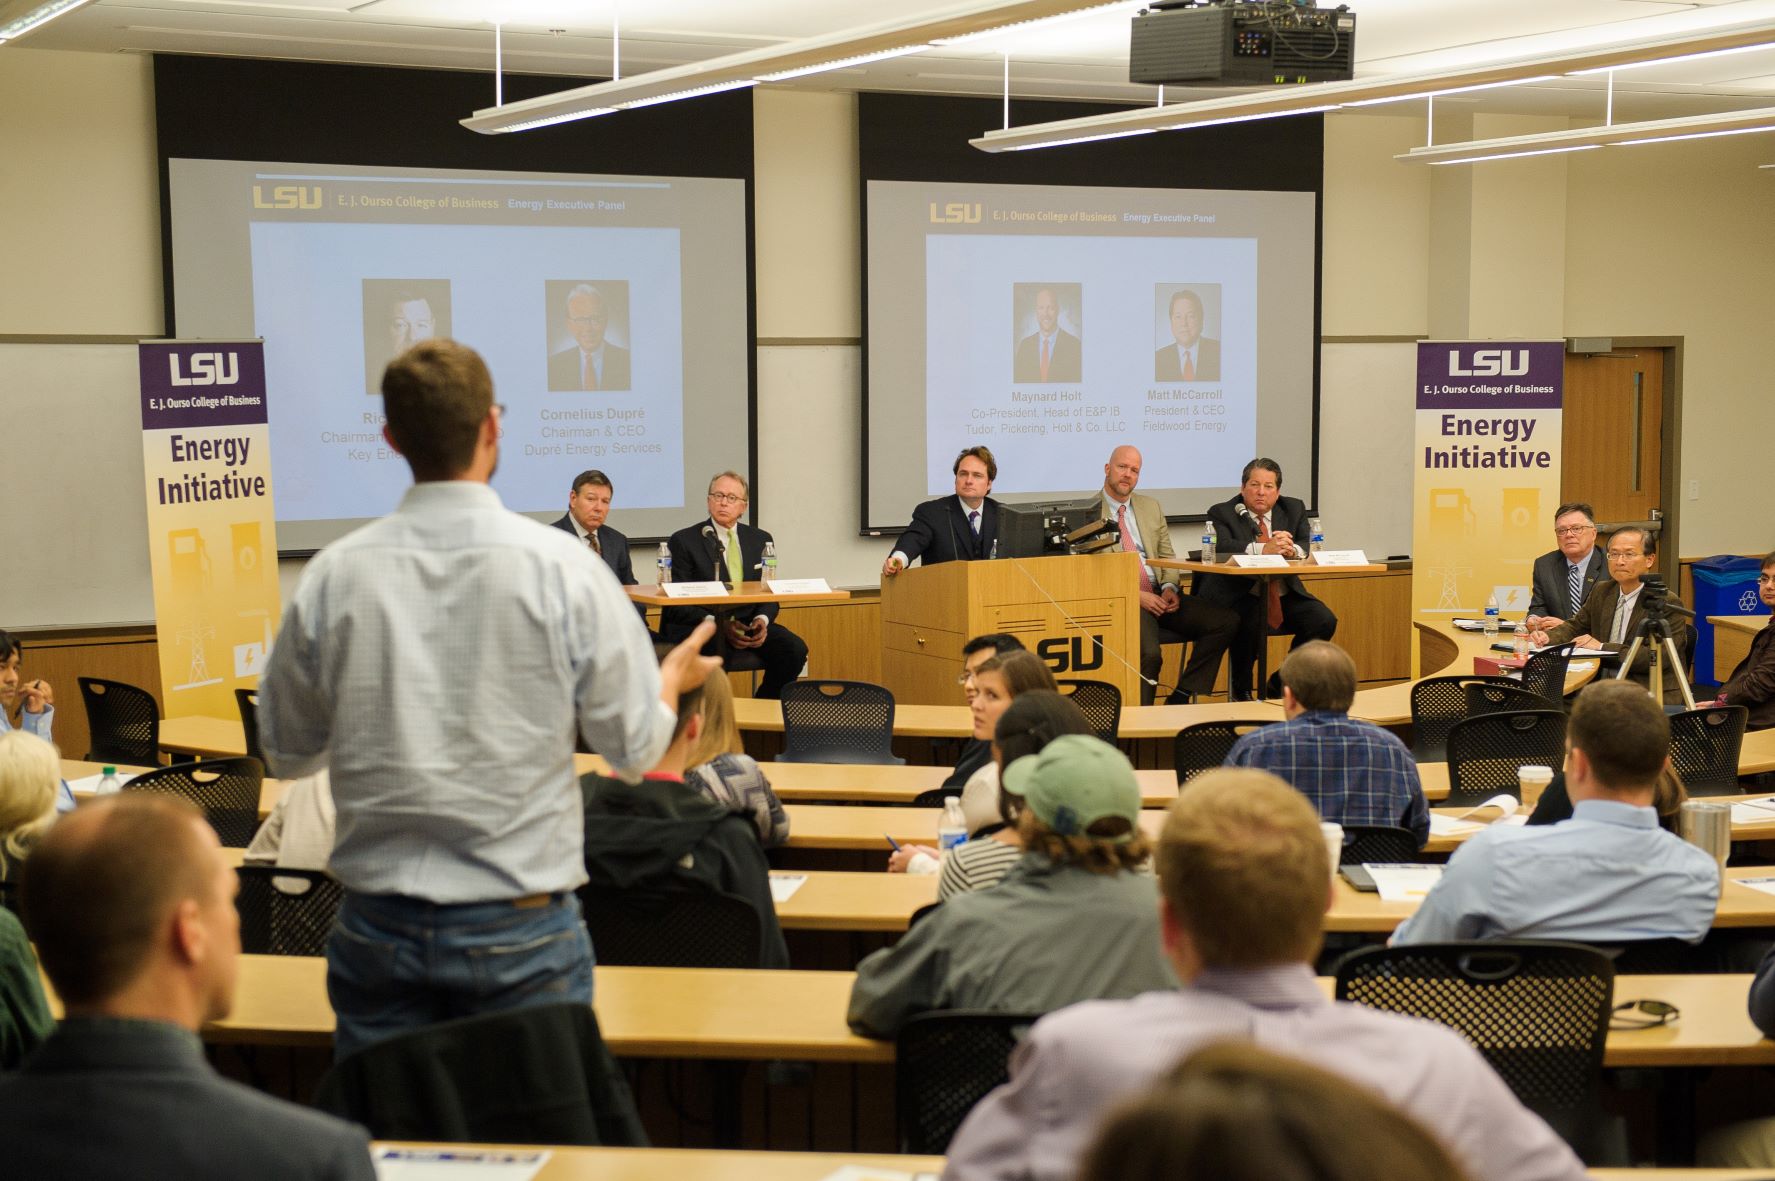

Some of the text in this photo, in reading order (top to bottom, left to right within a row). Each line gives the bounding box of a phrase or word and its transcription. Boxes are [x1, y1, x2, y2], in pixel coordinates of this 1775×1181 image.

[252, 186, 322, 209] LSU
[338, 195, 348, 206] E.
[361, 196, 393, 207] Ourso
[395, 196, 435, 210] College
[438, 196, 450, 208] of
[452, 197, 499, 209] Business
[508, 199, 544, 211] Energy
[547, 200, 594, 210] Executive
[598, 201, 625, 210] Panel
[930, 203, 981, 223] LSU
[1010, 211, 1035, 221] Ourso
[1037, 211, 1068, 223] College
[1070, 212, 1079, 222] of
[1080, 212, 1117, 222] Business
[1124, 213, 1151, 224] Energy
[1154, 214, 1191, 223] Executive
[1194, 214, 1216, 223] Panel
[169, 352, 239, 386] LSU
[1449, 350, 1529, 376] LSU
[1147, 389, 1222, 400] Matt McCarroll
[1424, 385, 1554, 395] E. J. Ourso College of Business
[150, 395, 261, 410] E. J. Ourso College of Business
[1012, 391, 1082, 403] Maynard Holt
[540, 408, 645, 421] Cornelius Dupré
[1044, 407, 1070, 417] Head
[1073, 407, 1084, 417] of
[1086, 406, 1107, 417] E&P
[1110, 406, 1120, 416] IB
[1144, 405, 1225, 416] President & CEO
[542, 425, 646, 438] Chairman & CEO
[1001, 424, 1048, 435] Pickering,
[1053, 423, 1072, 433] Holt
[1076, 422, 1082, 432] &
[1106, 422, 1126, 432] LLC
[1143, 420, 1227, 432] Fieldwood Energy
[1441, 414, 1536, 442] Energy
[320, 431, 385, 444] Chairman
[171, 435, 250, 466] Energy
[348, 449, 372, 462] Key
[524, 442, 662, 456] Dupré Energy Services
[1425, 445, 1551, 468] Initiative
[158, 470, 265, 505] Initiative
[1037, 635, 1103, 673] SU
